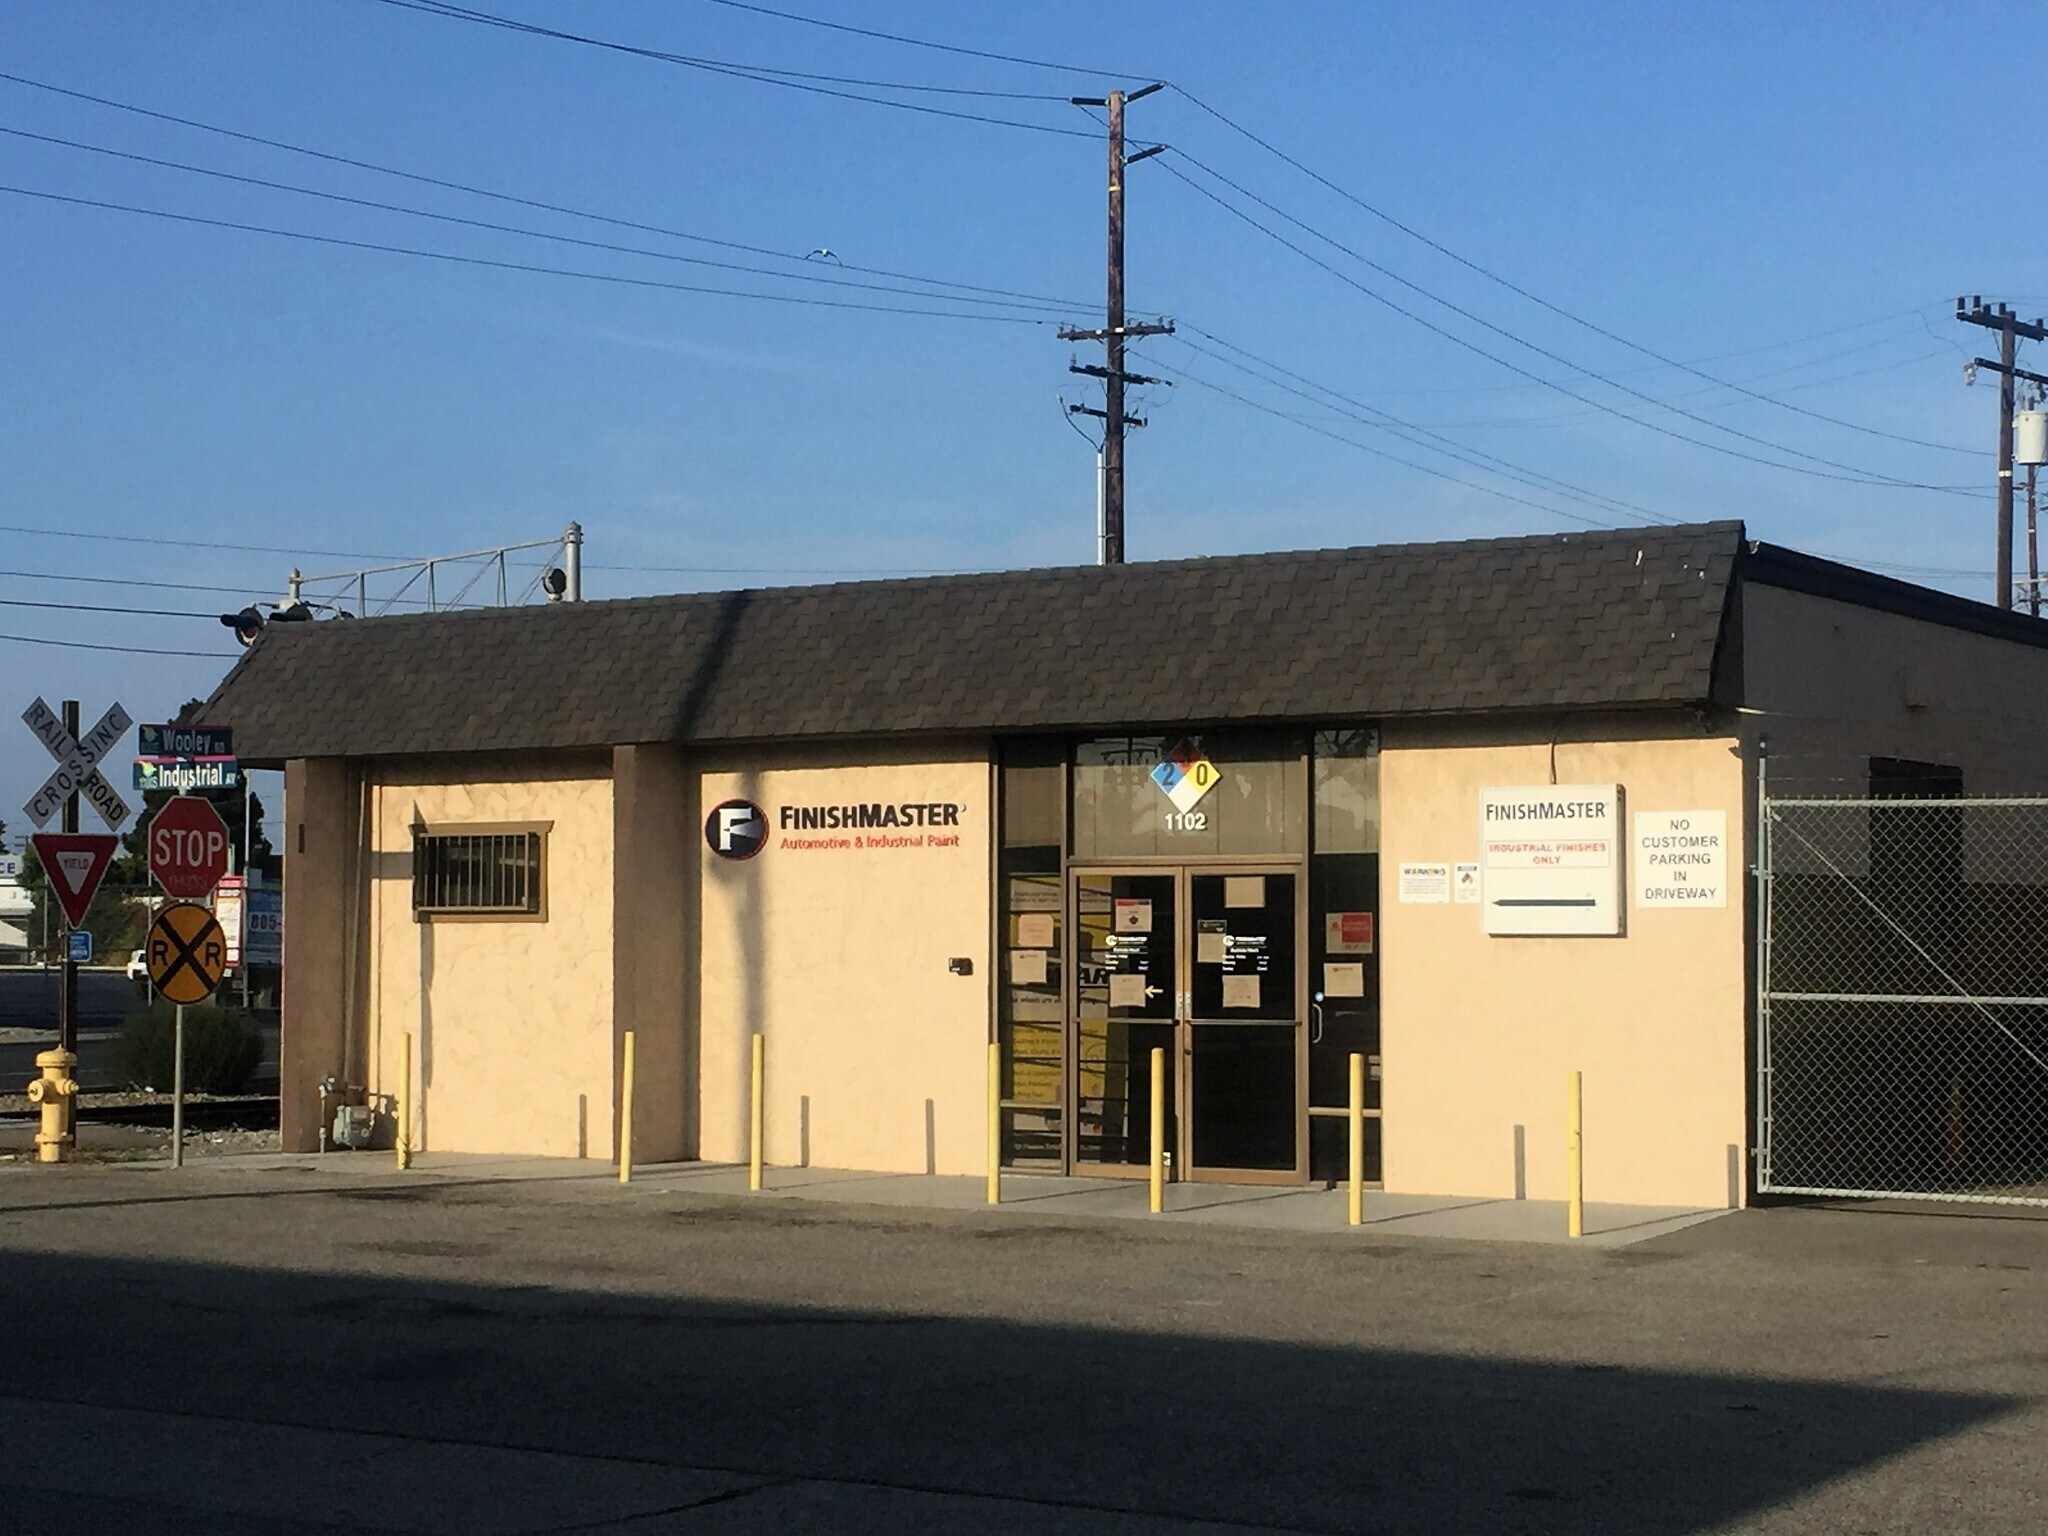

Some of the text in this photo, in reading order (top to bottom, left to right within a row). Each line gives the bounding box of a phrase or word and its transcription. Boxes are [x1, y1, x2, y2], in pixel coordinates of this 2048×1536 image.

[162, 729, 211, 755] Wooley
[30, 704, 124, 821] RAIL ROAD
[159, 763, 223, 787] Industrial
[1162, 760, 1208, 786] 2 0
[1486, 802, 1606, 820] FINISHMASTER
[1165, 812, 1207, 830] 1102
[1670, 819, 1690, 830] NO
[155, 828, 223, 867] STOP
[780, 834, 960, 849] Automotive & Industrial Paint
[1489, 843, 1606, 852] INDUSTRIAL FINISHES
[1642, 836, 1719, 848] CUSTOMER
[63, 858, 89, 870] YIELD
[1533, 856, 1561, 864] ONLY
[1649, 853, 1711, 865] PARKING
[1673, 871, 1687, 881] IN
[1645, 887, 1716, 899] DRIVEWAY
[152, 940, 221, 966] R R
